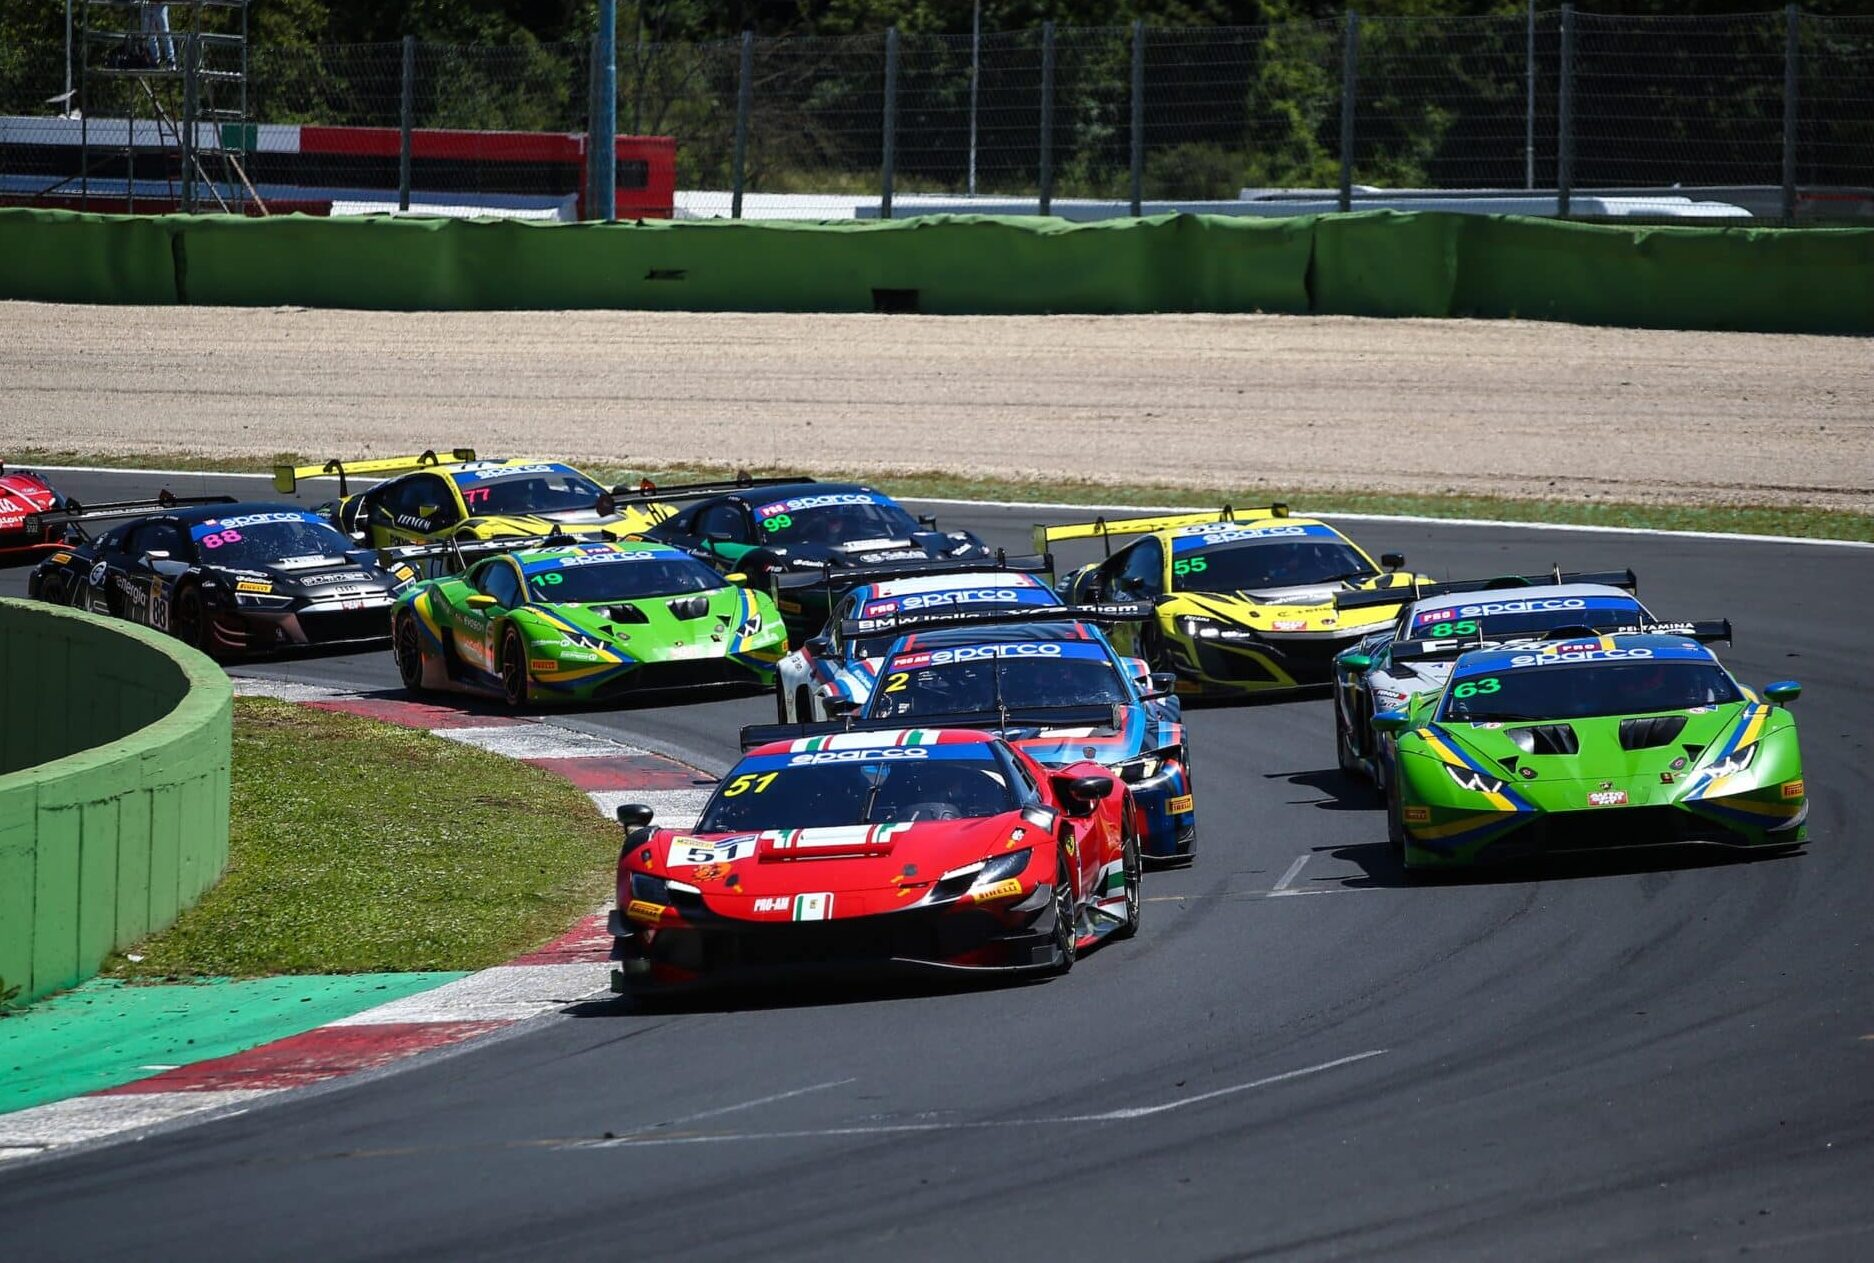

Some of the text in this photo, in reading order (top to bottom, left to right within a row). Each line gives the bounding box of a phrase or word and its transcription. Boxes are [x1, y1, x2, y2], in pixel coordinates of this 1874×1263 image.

[463, 488, 490, 504] 77
[787, 494, 875, 511] sparco
[220, 513, 304, 529] sparco
[763, 514, 792, 532] 99
[203, 530, 242, 548] 88
[1202, 527, 1307, 544] sparco
[559, 551, 656, 566] sparco
[1174, 557, 1207, 575] 55
[531, 573, 563, 587] 19
[869, 590, 1018, 615] PRO sparco
[1423, 600, 1586, 622] PRO sparco
[152, 597, 167, 628] 88
[1432, 620, 1478, 637] 85
[931, 642, 1061, 666] sparco
[1511, 648, 1653, 667] sparco
[884, 672, 909, 693] 2
[1454, 677, 1501, 698] 63
[788, 748, 928, 766] sparco
[724, 771, 779, 797] 51
[687, 844, 738, 863] 51
